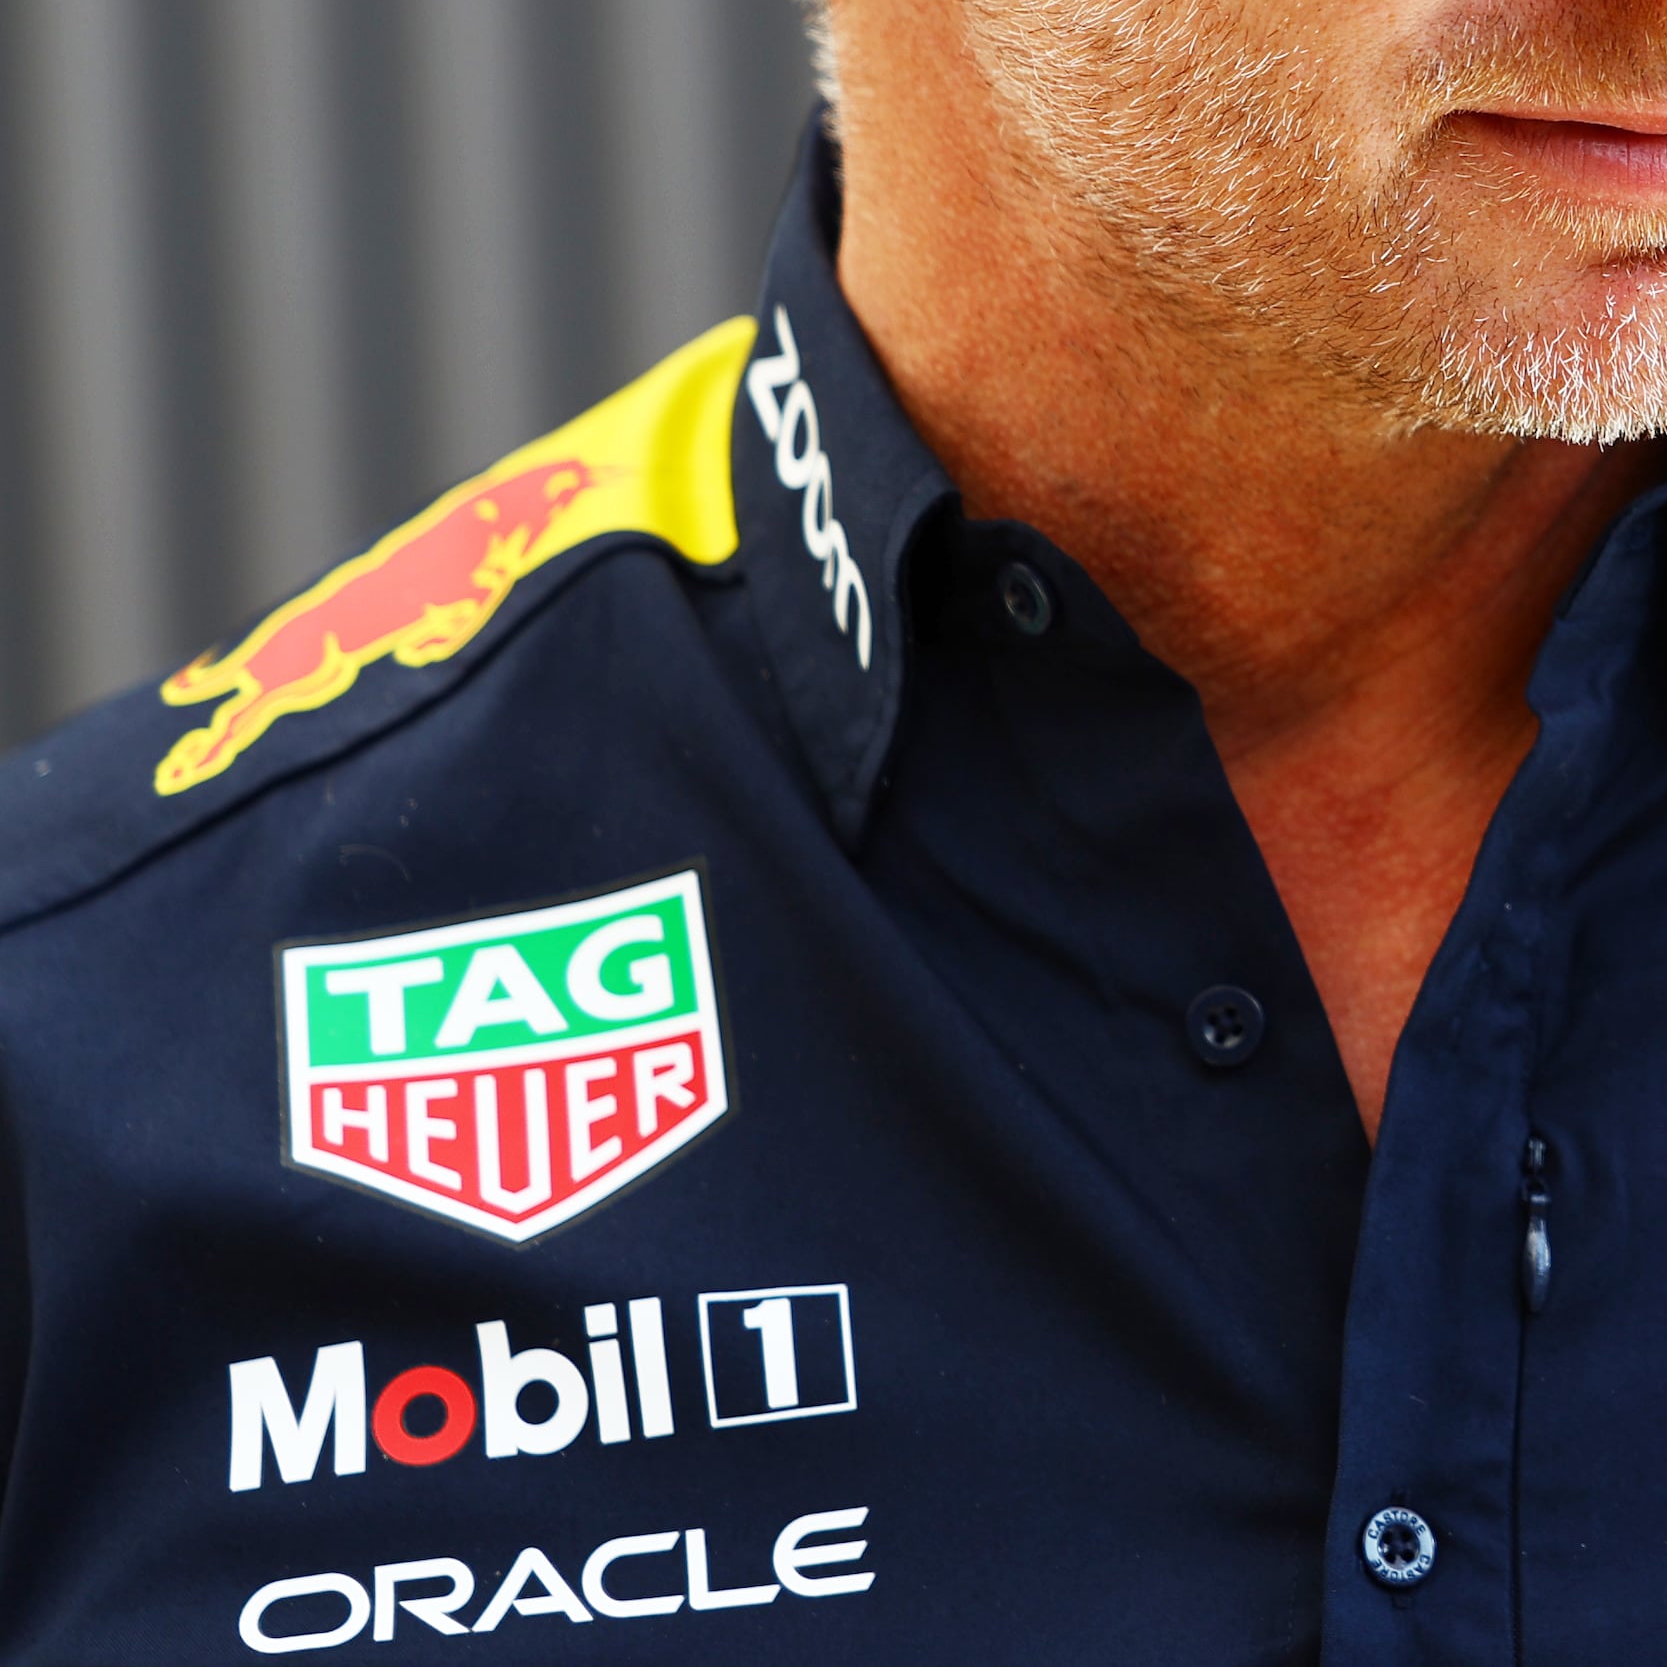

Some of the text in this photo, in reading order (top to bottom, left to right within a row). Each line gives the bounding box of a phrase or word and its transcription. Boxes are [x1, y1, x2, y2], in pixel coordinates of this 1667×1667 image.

[324, 913, 674, 1055] TAG
[323, 1049, 697, 1212] HEUER
[228, 1296, 800, 1493] Mobil 1
[238, 1506, 876, 1654] ORACLE
[1367, 1510, 1427, 1540] CASTORE
